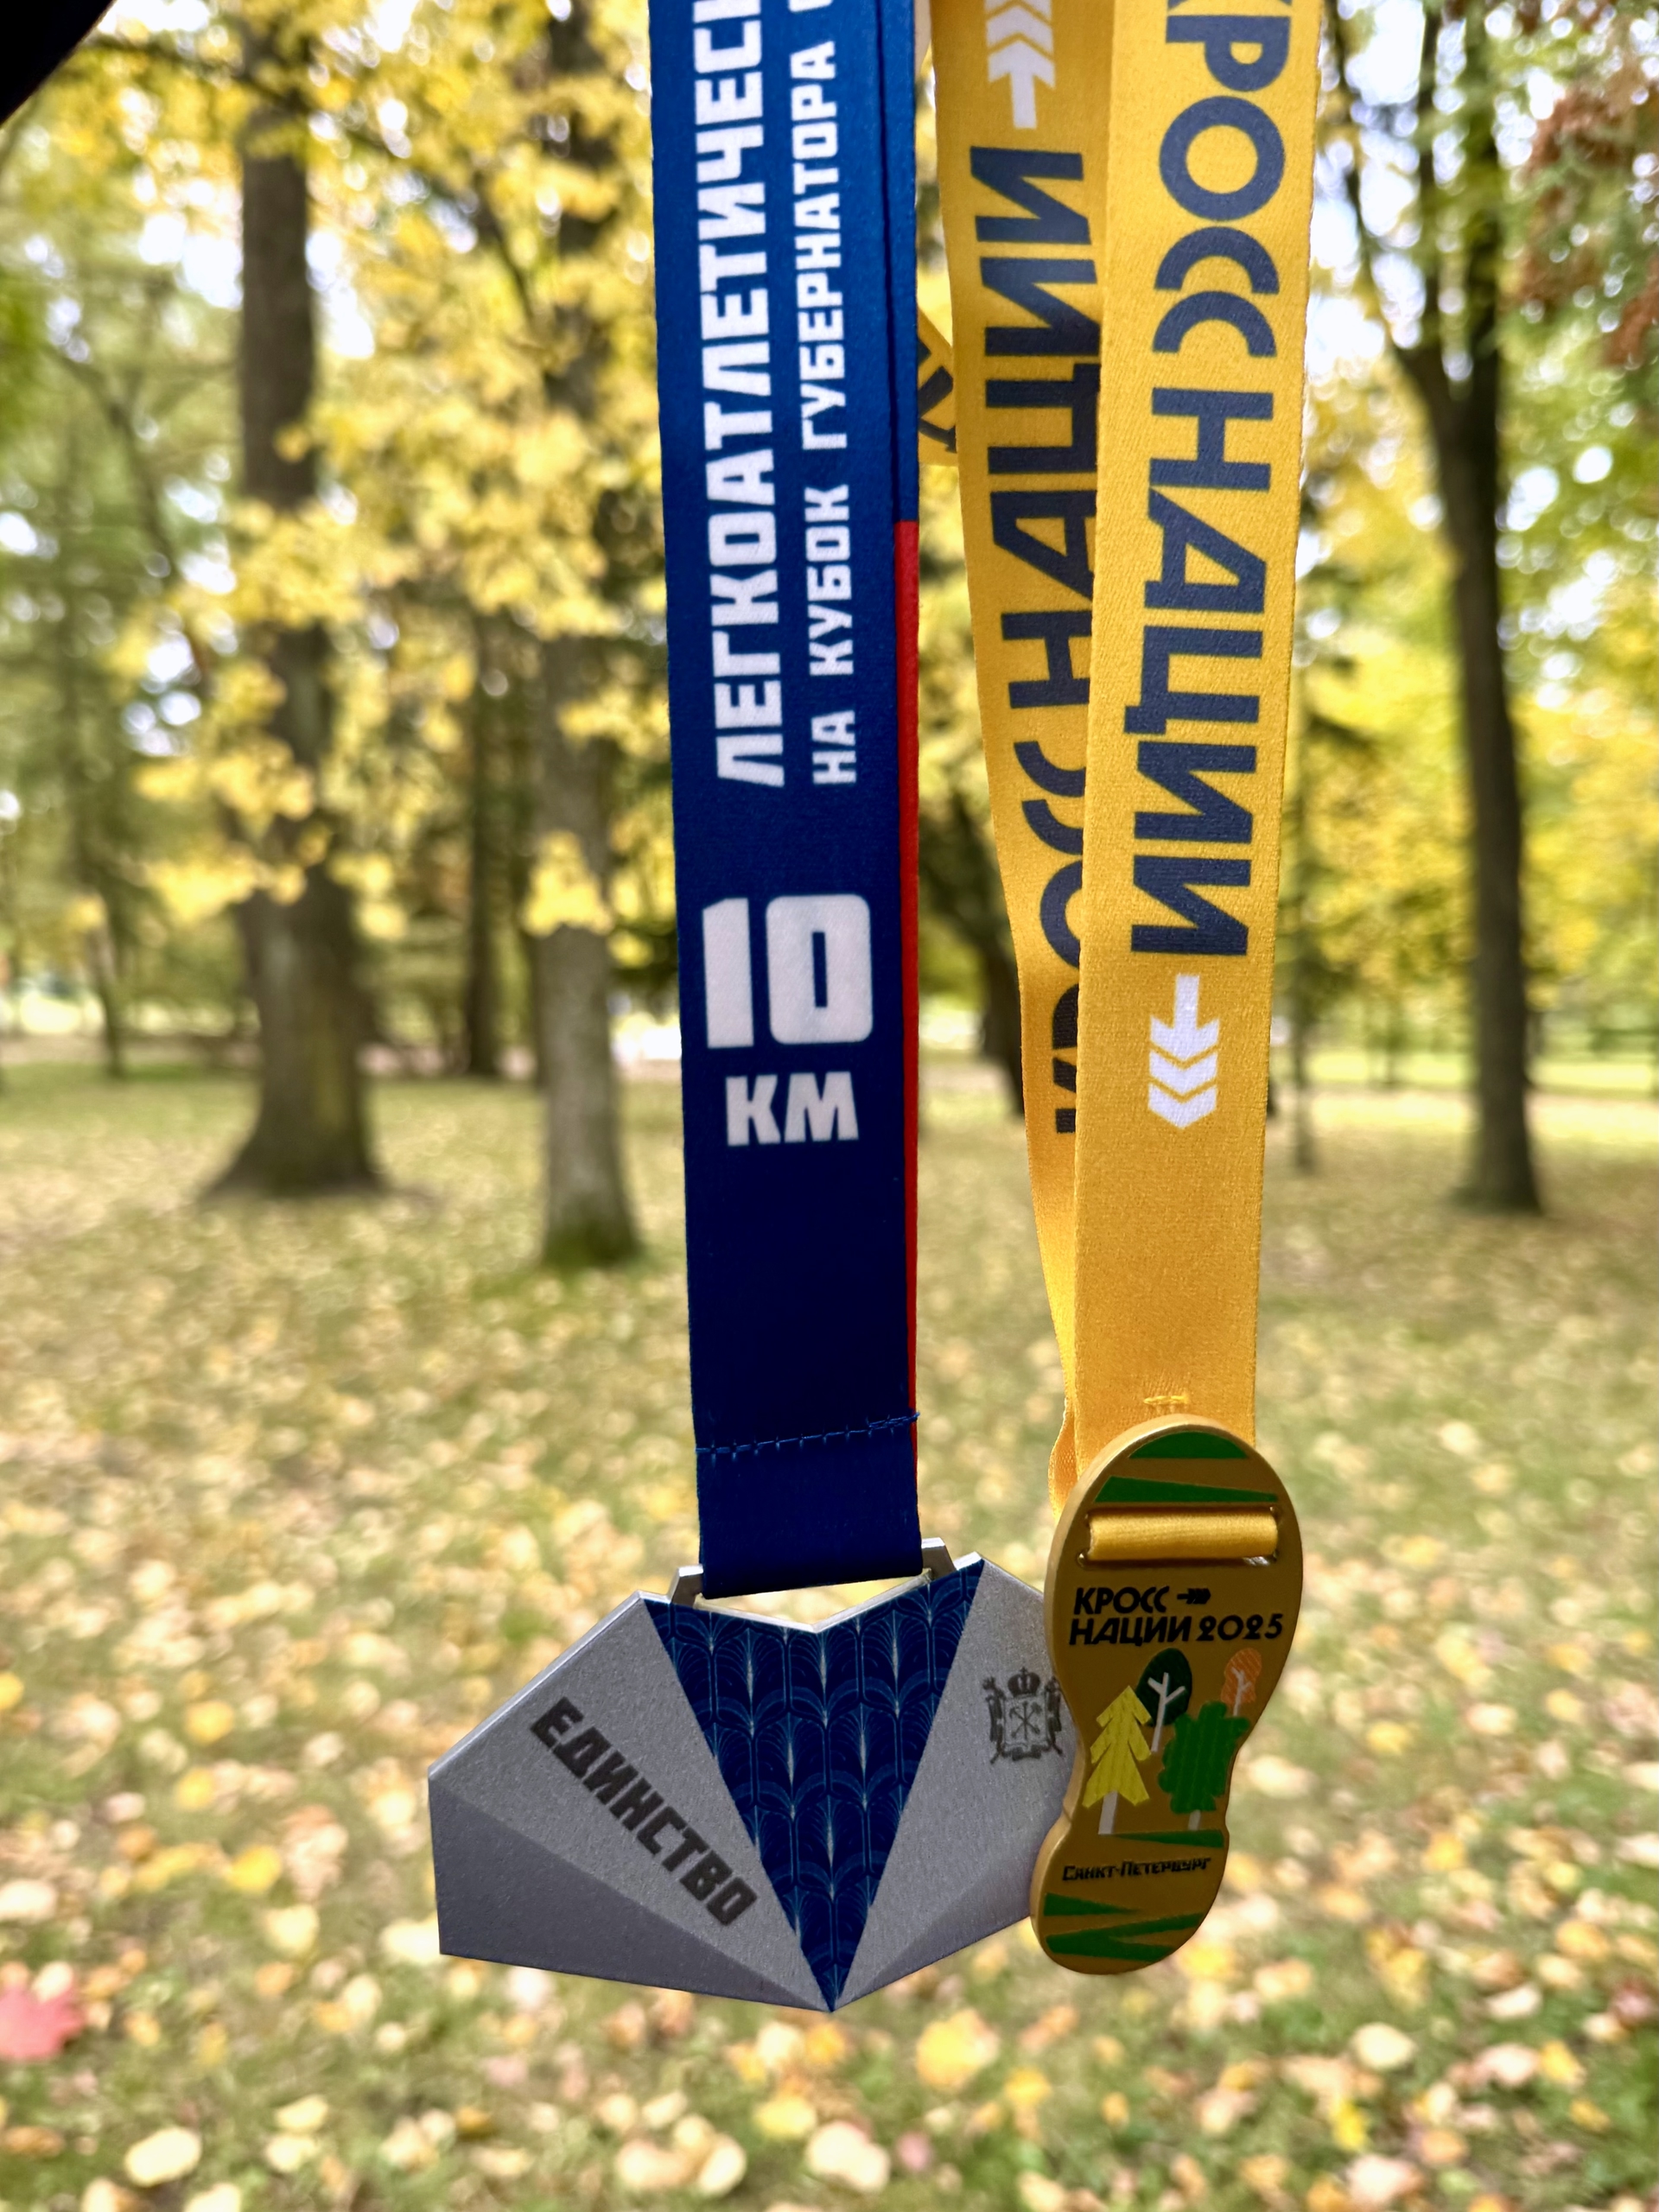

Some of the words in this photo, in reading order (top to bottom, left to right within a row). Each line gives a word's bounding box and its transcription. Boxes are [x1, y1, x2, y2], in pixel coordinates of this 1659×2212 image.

[790, 41, 848, 450] ГУБЕРНАТОРА
[1153, 0, 1292, 359] РОСС
[969, 146, 1101, 709] НАЦИИ
[804, 484, 854, 676] КУБОК
[1123, 387, 1274, 957] НАЦИИ
[810, 709, 856, 785] НА
[702, 893, 873, 1049] 10
[726, 1071, 859, 1146] КМ
[1069, 1616, 1192, 1646] НАЦИИ
[1196, 1613, 1283, 1641] 2025
[1074, 1586, 1169, 1615] КРОСС
[529, 1696, 757, 1927] ЕДИНСТВО
